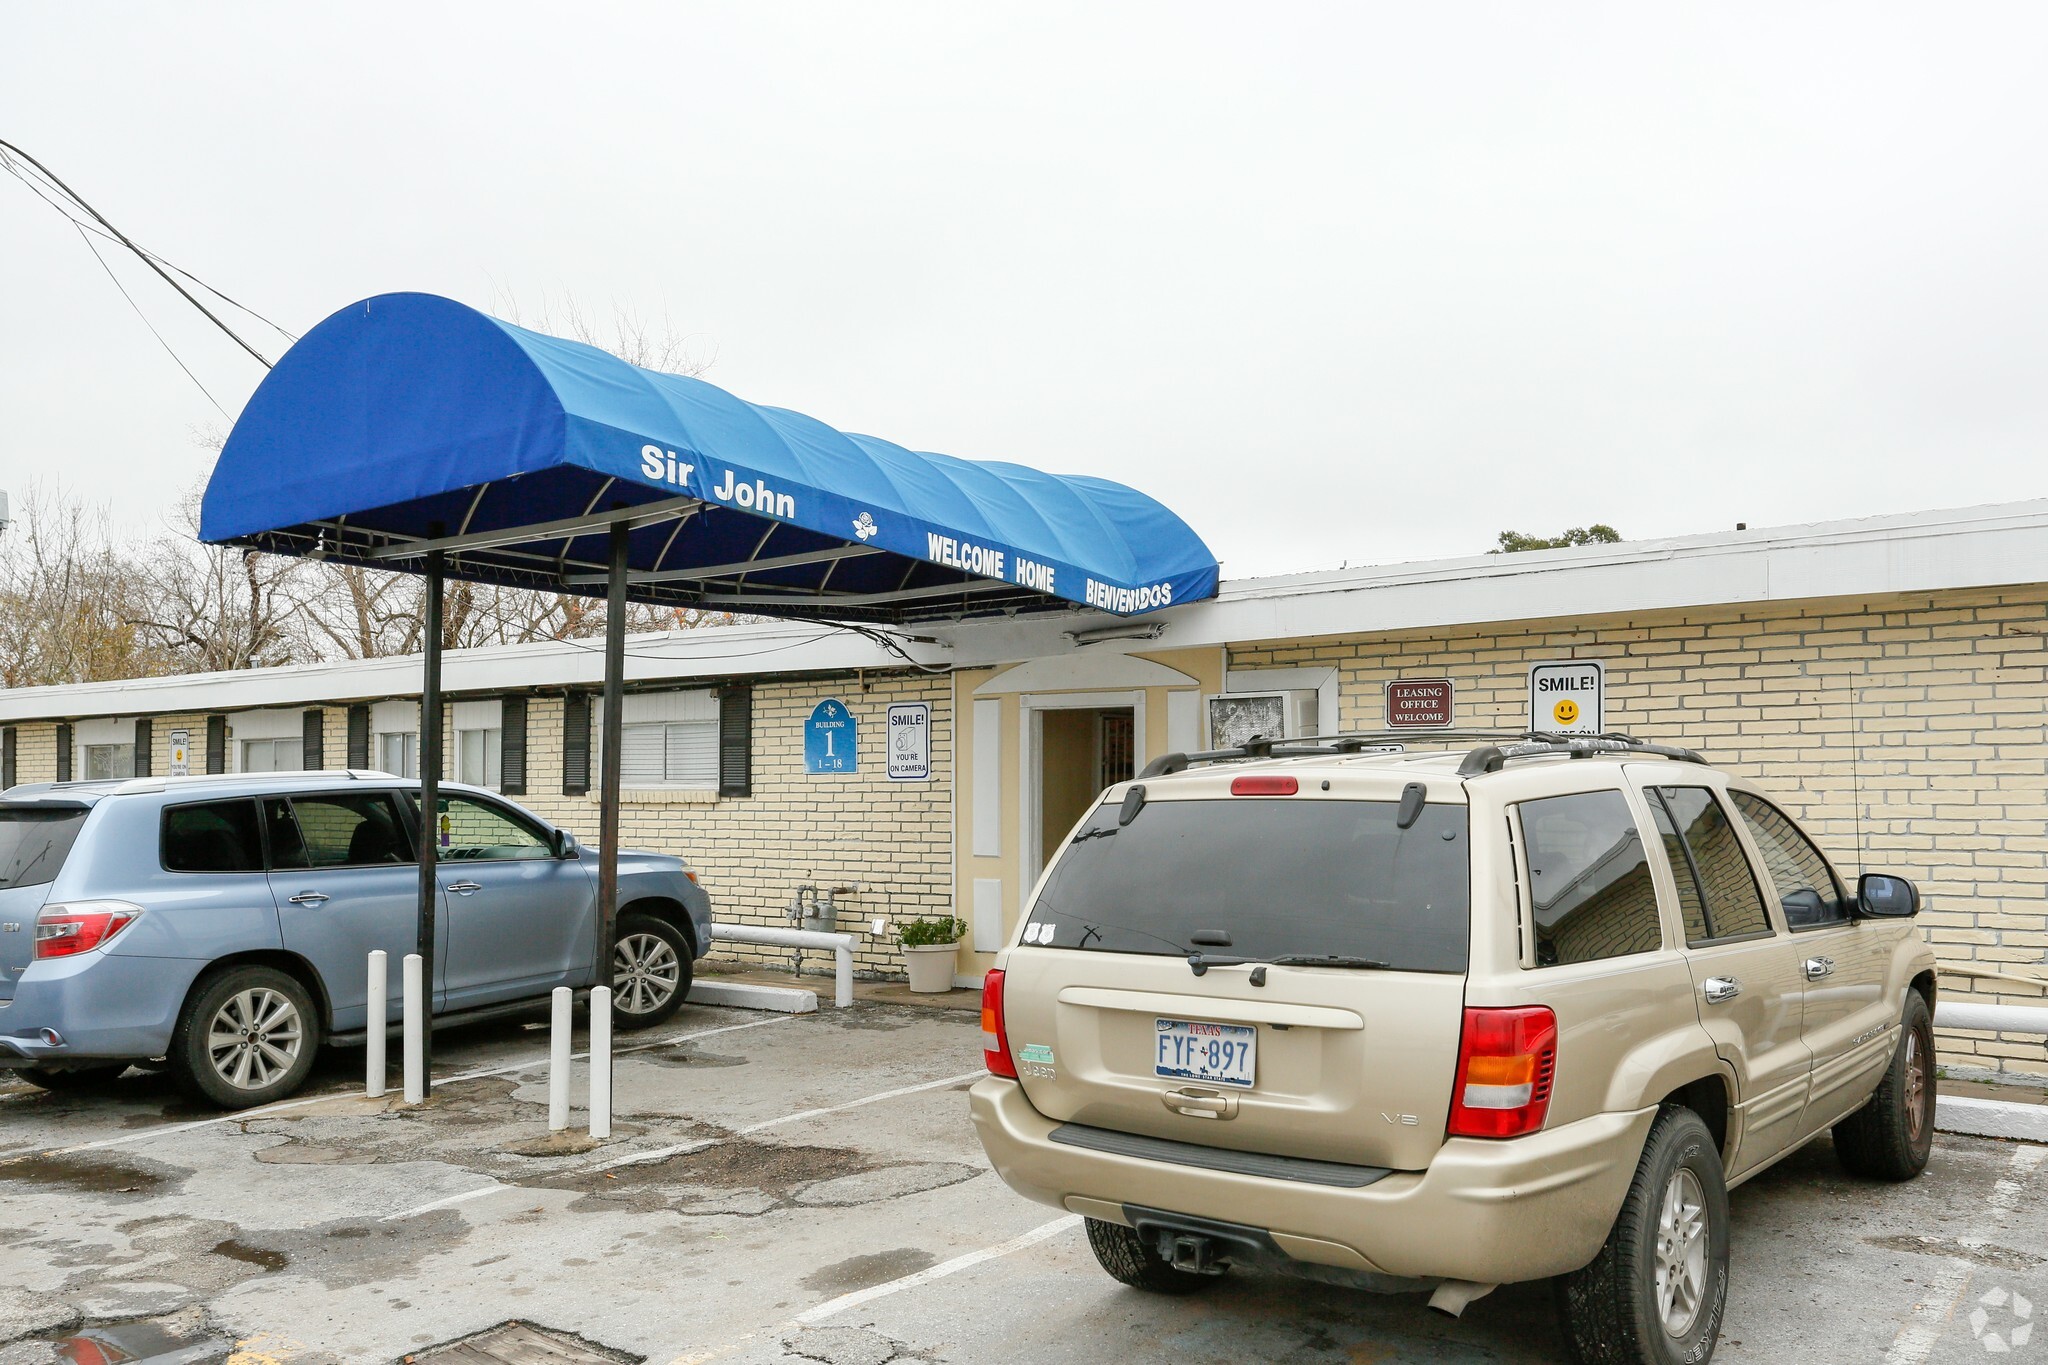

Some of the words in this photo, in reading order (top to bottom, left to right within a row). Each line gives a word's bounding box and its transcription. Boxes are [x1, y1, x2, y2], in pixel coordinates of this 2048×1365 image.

[641, 445, 694, 487] Sir
[714, 470, 795, 519] John
[928, 532, 1004, 579] WELCOME
[1016, 557, 1055, 594] HOME
[1086, 578, 1172, 612] BIENVENIDOS
[1538, 676, 1595, 692] SMILE!
[1396, 688, 1443, 698] LEASING
[1400, 699, 1439, 709] OFFICE
[891, 714, 924, 726] SMILE!
[1395, 712, 1444, 722] WELCOME
[815, 721, 845, 729] BUILDING
[825, 730, 835, 757] 1
[896, 753, 918, 761] YOU'RE
[900, 764, 926, 772] CAMERA
[1188, 1023, 1221, 1037] TEXAS
[1023, 1061, 1057, 1081] Jeep
[1381, 1112, 1419, 1126] V8
